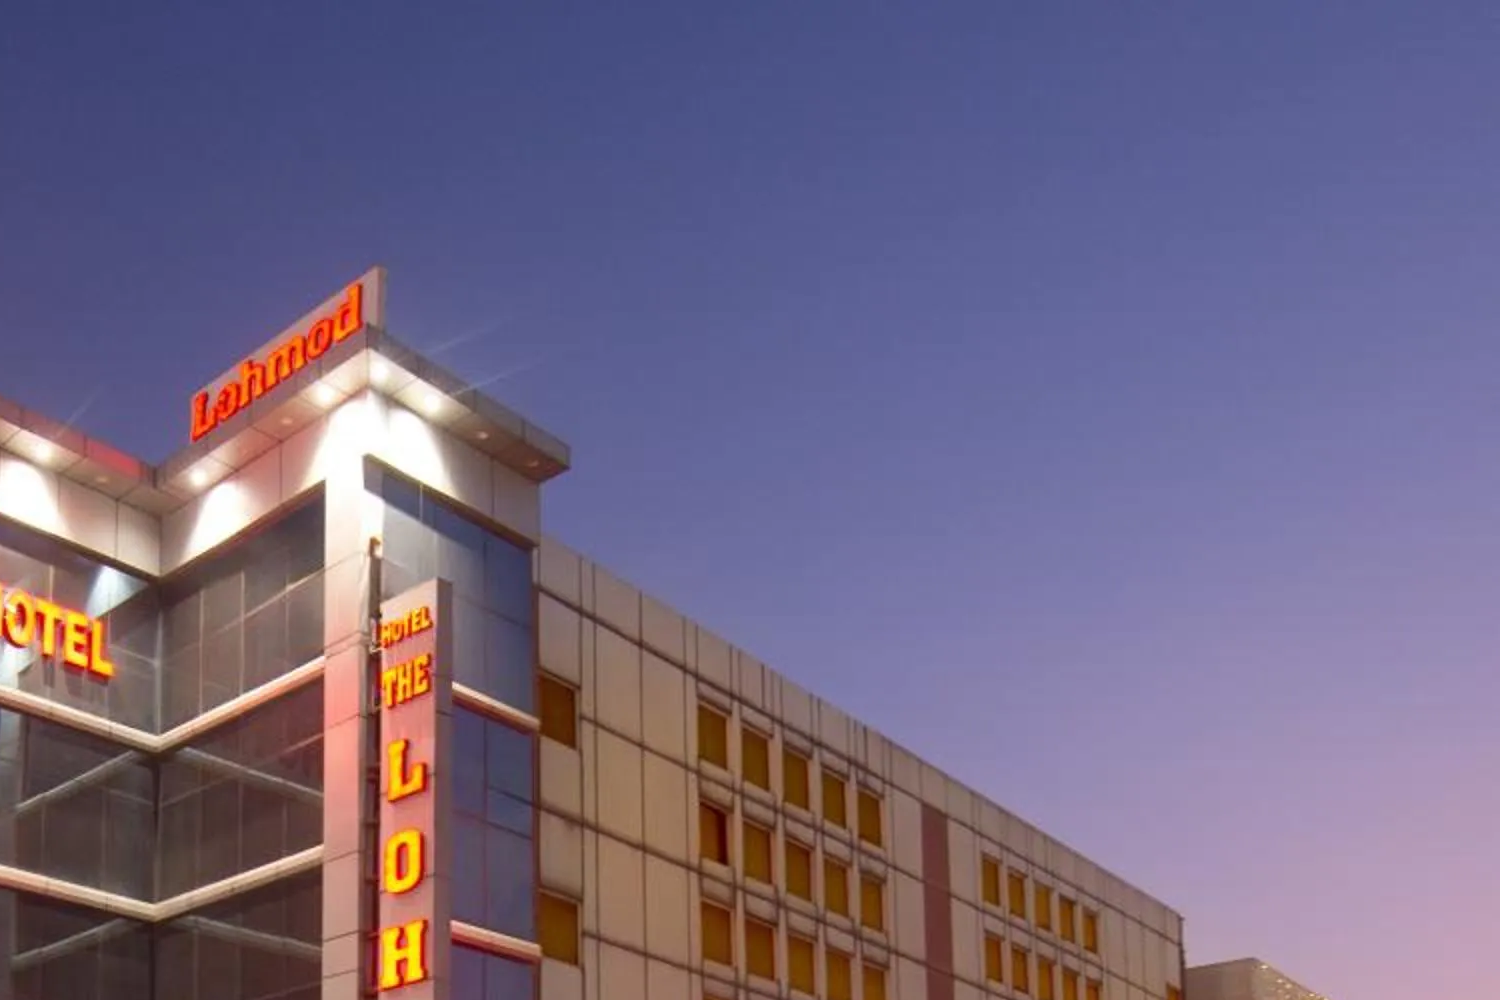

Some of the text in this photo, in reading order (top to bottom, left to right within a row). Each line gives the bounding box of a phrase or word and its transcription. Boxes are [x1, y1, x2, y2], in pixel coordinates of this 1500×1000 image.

[191, 282, 364, 441] Lohmod
[380, 605, 433, 648] HOTEL
[380, 652, 431, 709] THE
